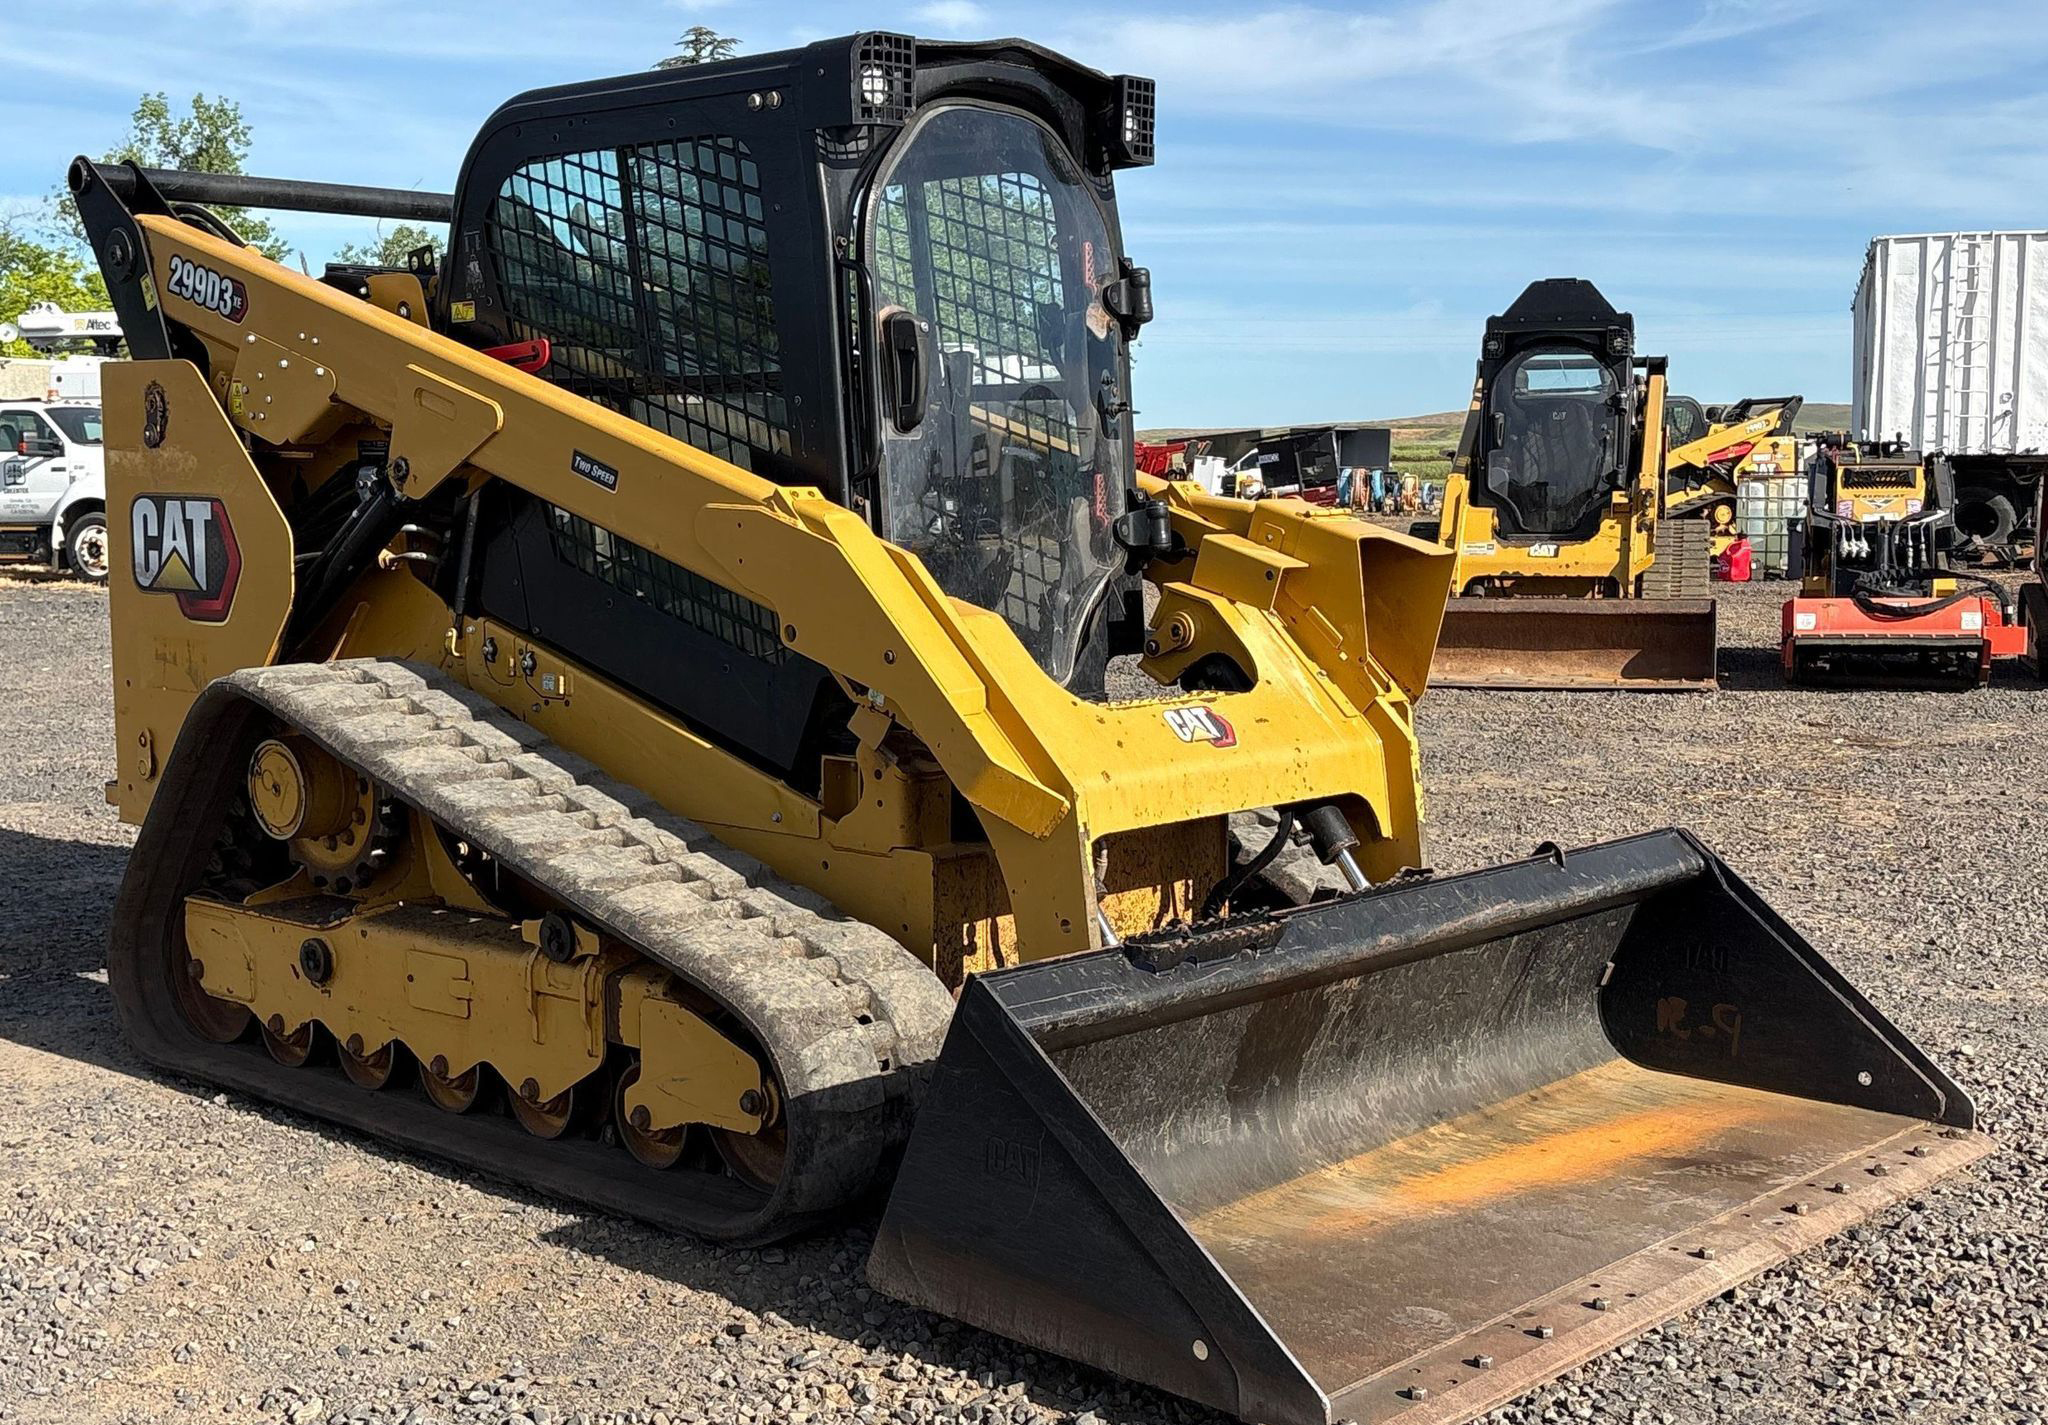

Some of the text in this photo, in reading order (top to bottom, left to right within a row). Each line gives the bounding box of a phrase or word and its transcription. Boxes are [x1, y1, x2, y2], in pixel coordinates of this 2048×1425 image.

[167, 255, 233, 316] 299D3
[86, 318, 111, 331] Altec
[132, 497, 212, 591] CAT
[1163, 705, 1221, 742] CAT
